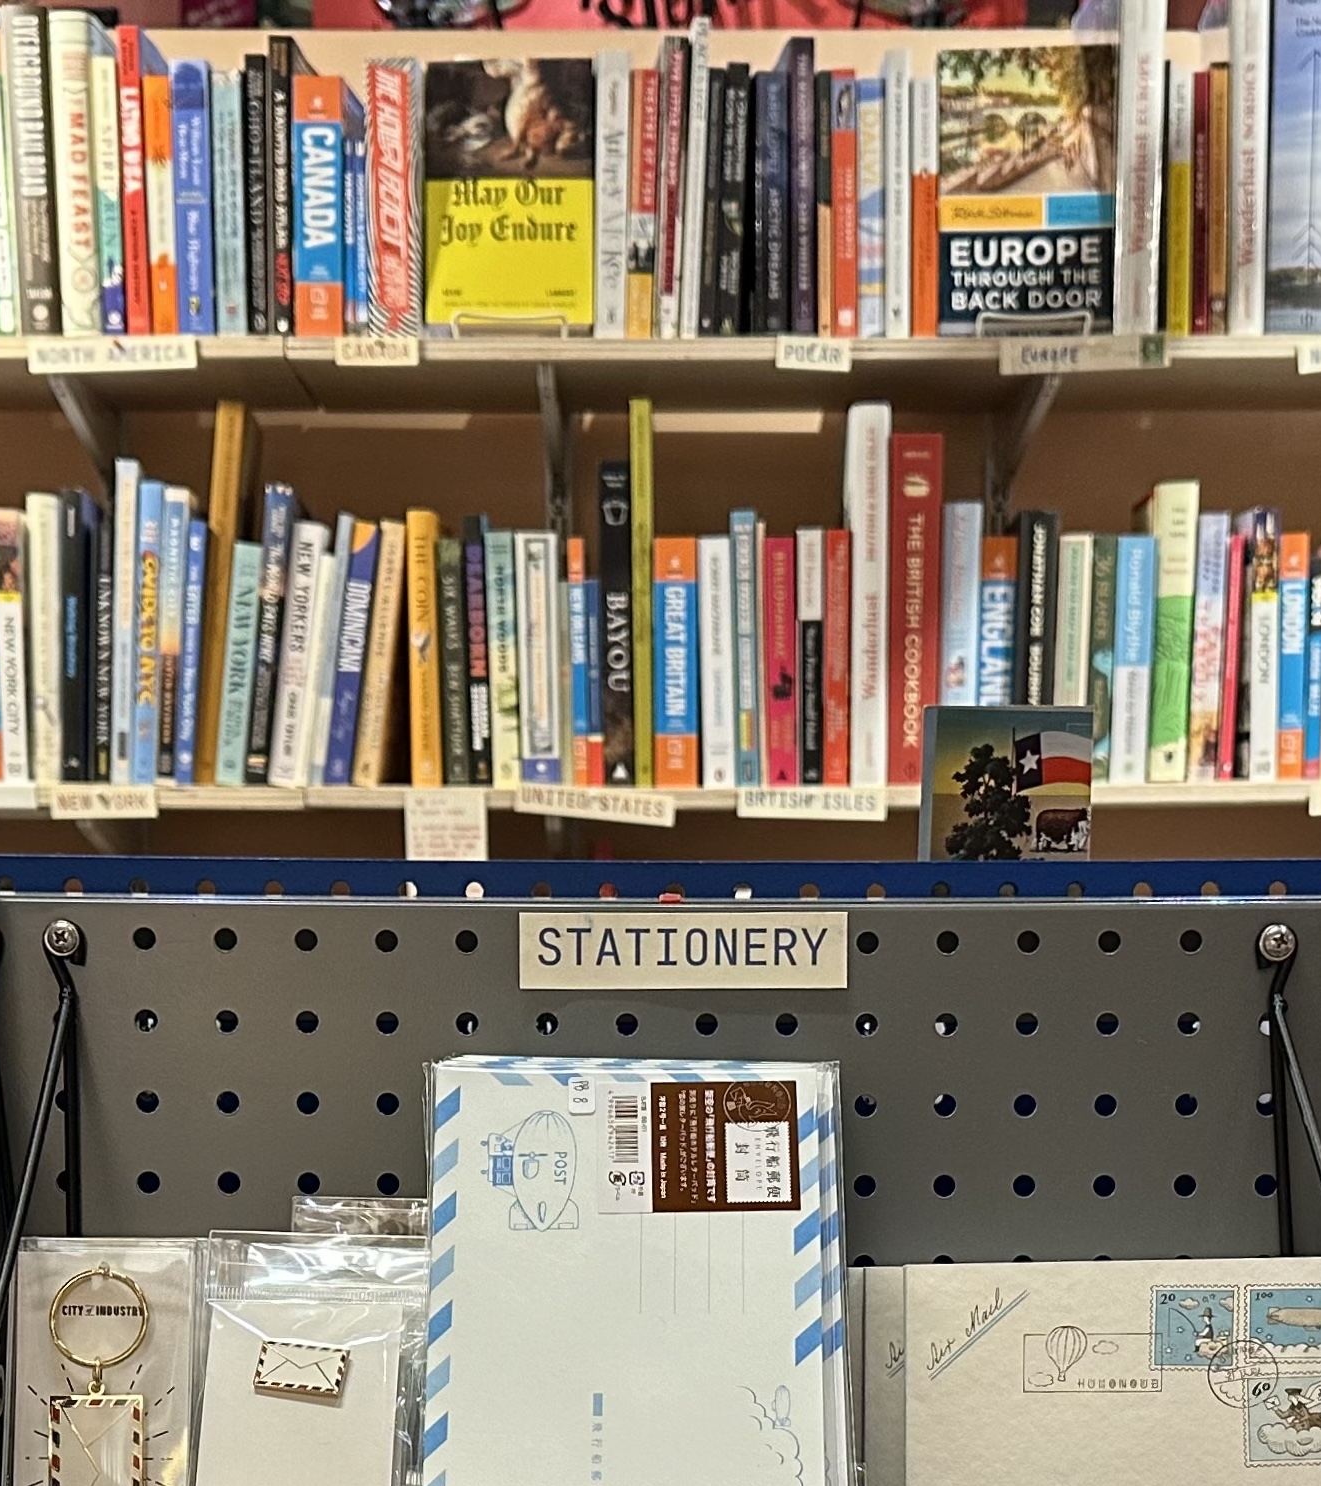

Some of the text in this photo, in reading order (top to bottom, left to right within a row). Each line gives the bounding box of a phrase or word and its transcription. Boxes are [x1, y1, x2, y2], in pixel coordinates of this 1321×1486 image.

[299, 125, 336, 249] CANADA
[451, 179, 566, 209] May Our
[439, 214, 578, 245] Joy Endure
[948, 235, 1103, 268] EUROPE
[950, 268, 1102, 289] THROUGH THE
[949, 288, 1103, 311] BACK DOOR
[35, 345, 185, 363] NORTH AMERICA
[337, 581, 373, 674] DOMINICANA
[606, 590, 631, 694] BAYOU
[902, 513, 925, 748] THE BRITISH COOKBOOK
[664, 585, 688, 718] GREAT BRITAIN
[537, 926, 829, 967] STATIONERY
[553, 1150, 567, 1185] POST
[1251, 1382, 1272, 1398] 60
